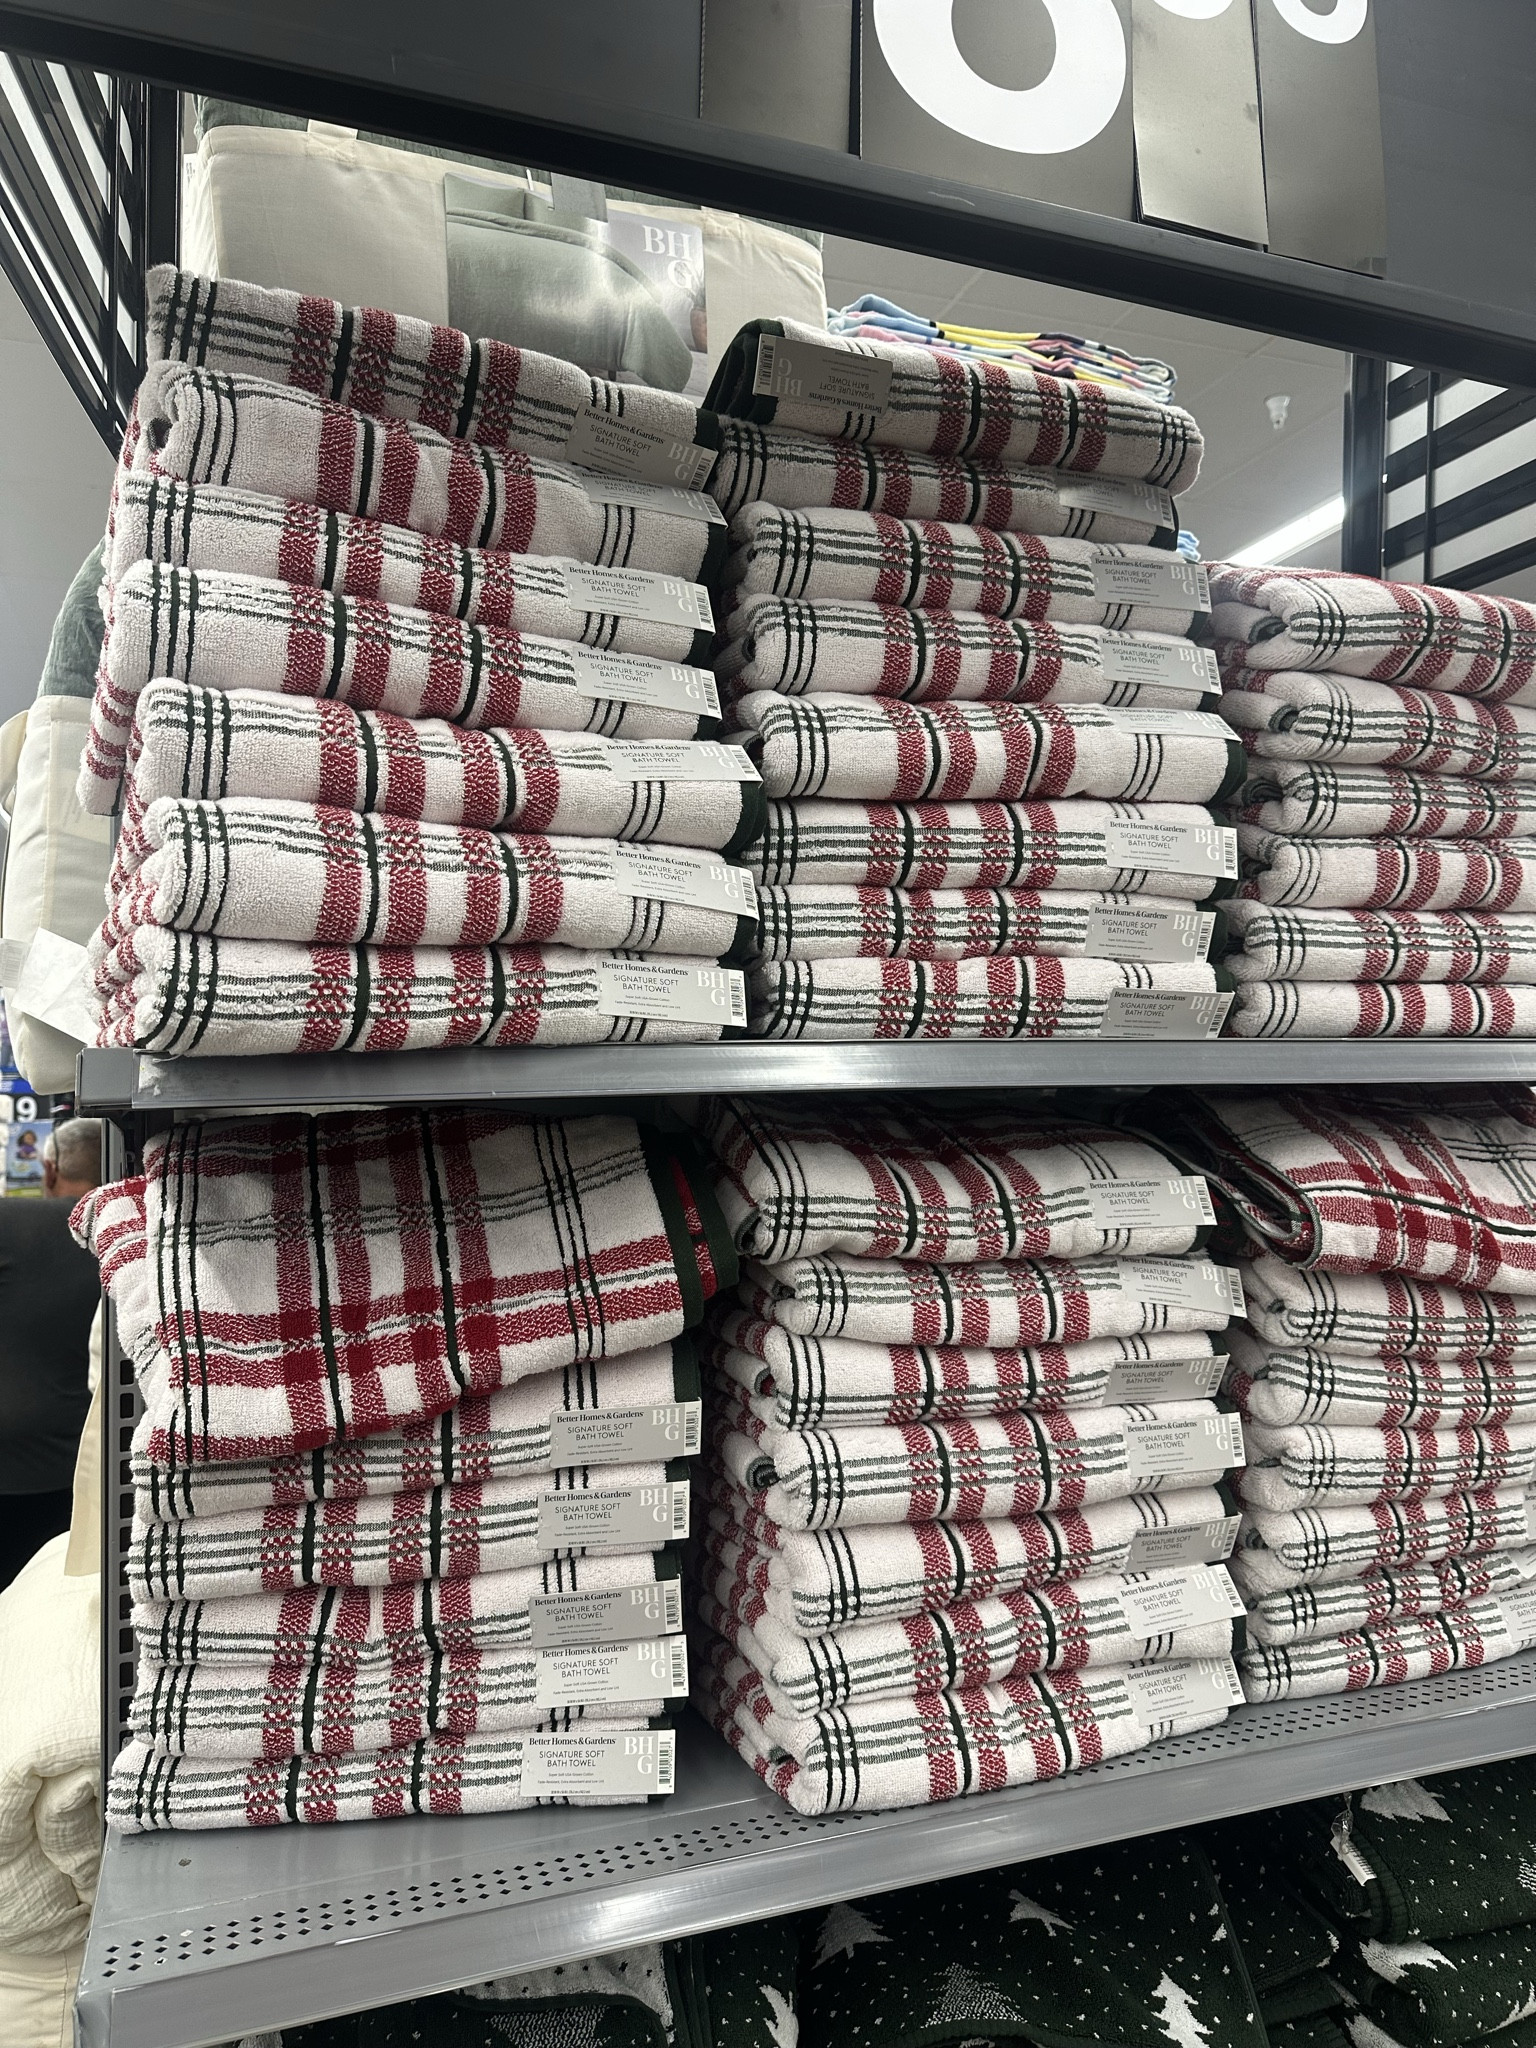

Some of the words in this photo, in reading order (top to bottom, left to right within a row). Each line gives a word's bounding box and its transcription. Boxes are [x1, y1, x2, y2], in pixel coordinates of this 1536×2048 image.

[643, 225, 691, 260] BH
[667, 260, 693, 289] G
[584, 408, 605, 422] Better
[590, 424, 632, 444] SIGNATURE
[633, 439, 651, 451] SOFT
[595, 436, 615, 447] BATH
[615, 443, 640, 457] TOWEL
[667, 442, 698, 465] BH
[674, 463, 691, 480] G
[569, 565, 591, 574] Better
[592, 569, 618, 578] Homes
[624, 575, 655, 584] Gardens
[581, 577, 625, 589] SIGNATURE
[627, 584, 646, 592] SOFT
[591, 585, 611, 593] BATH
[613, 588, 639, 598] TOWEL
[662, 580, 691, 597] BH
[678, 597, 692, 611] G
[1102, 637, 1120, 645] Better
[1112, 648, 1148, 658] SIGNATURE
[1178, 647, 1203, 663] BH
[1138, 657, 1160, 665] TOWEL
[1192, 662, 1204, 676] G
[1110, 820, 1129, 828] Better
[1130, 822, 1154, 830] Homes
[1159, 825, 1187, 833] Gardens
[1120, 832, 1159, 841] SIGNATURE
[1161, 835, 1178, 843] SOFT
[1194, 828, 1220, 844] BH
[1147, 841, 1171, 849] TOWEL
[1207, 844, 1220, 859] G
[616, 849, 638, 858] Better
[639, 853, 665, 863] Homes
[671, 859, 701, 869] Gardens
[628, 861, 672, 874] SIGNATURE
[674, 869, 692, 877] SOFT
[638, 869, 658, 877] BATH
[659, 873, 686, 883] TOWEL
[708, 865, 737, 883] BH
[724, 882, 738, 896] G
[1094, 907, 1113, 915] Better
[1113, 908, 1135, 916] Homes
[1141, 911, 1167, 919] Gardens
[1102, 919, 1139, 928] SIGNATURE
[1172, 914, 1199, 931] BH
[1126, 928, 1148, 937] TOWEL
[1182, 931, 1195, 947] G
[602, 961, 624, 970] Better
[625, 963, 651, 972] Homes
[658, 967, 688, 976] Gardens
[613, 974, 657, 985] SIGNATURE
[659, 978, 678, 986] SOFT
[696, 970, 725, 989] BH
[622, 983, 643, 991] BATH
[644, 985, 671, 994] TOWEL
[711, 989, 725, 1005] G
[1166, 1179, 1193, 1194] BH
[1101, 1191, 1137, 1199] SIGNATURE
[1182, 1194, 1196, 1209] G
[612, 1411, 643, 1419] Gardens
[652, 1407, 680, 1425] BH
[567, 1424, 611, 1434] SIGNATURE
[613, 1422, 633, 1431] SOFT
[665, 1424, 679, 1441] G
[1203, 1418, 1227, 1435] BH
[576, 1433, 596, 1441] BATH
[598, 1431, 624, 1439] TOWEL
[1137, 1434, 1173, 1443] SIGNATURE
[1174, 1432, 1190, 1440] SOFT
[1216, 1434, 1228, 1450] G
[567, 1493, 593, 1501] Homes
[600, 1491, 631, 1499] Gardens
[639, 1488, 668, 1506] BH
[555, 1504, 599, 1514] SIGNATURE
[601, 1503, 620, 1511] SOFT
[653, 1505, 667, 1522] G
[563, 1513, 584, 1521] BATH
[585, 1512, 612, 1520] TOWEL
[1191, 1570, 1218, 1590] BH
[590, 1592, 622, 1600] Gardens
[630, 1587, 660, 1605] BH
[1133, 1592, 1168, 1606] SIGNATURE
[1168, 1589, 1183, 1598] SOFT
[1210, 1586, 1224, 1602] G
[546, 1605, 590, 1616] SIGNATURE
[592, 1603, 611, 1611] SOFT
[645, 1603, 659, 1619] G
[1143, 1603, 1160, 1612] BATH
[1159, 1598, 1181, 1607] TOWEL
[555, 1614, 575, 1622] BATH
[542, 1650, 564, 1658] Better
[565, 1648, 591, 1656] Homes
[597, 1645, 628, 1653] Gardens
[636, 1641, 666, 1661] BH
[553, 1659, 596, 1670] SIGNATURE
[599, 1657, 618, 1666] SOFT
[651, 1659, 666, 1678] G
[561, 1670, 582, 1678] BATH
[583, 1667, 610, 1676] TOWEL
[552, 1737, 578, 1745] Homes
[624, 1736, 653, 1755] BH
[539, 1750, 583, 1759] SIGNATURE
[585, 1750, 605, 1758] SOFT
[547, 1759, 567, 1767] BATH
[569, 1759, 596, 1767] TOWEL
[637, 1755, 652, 1774] G
